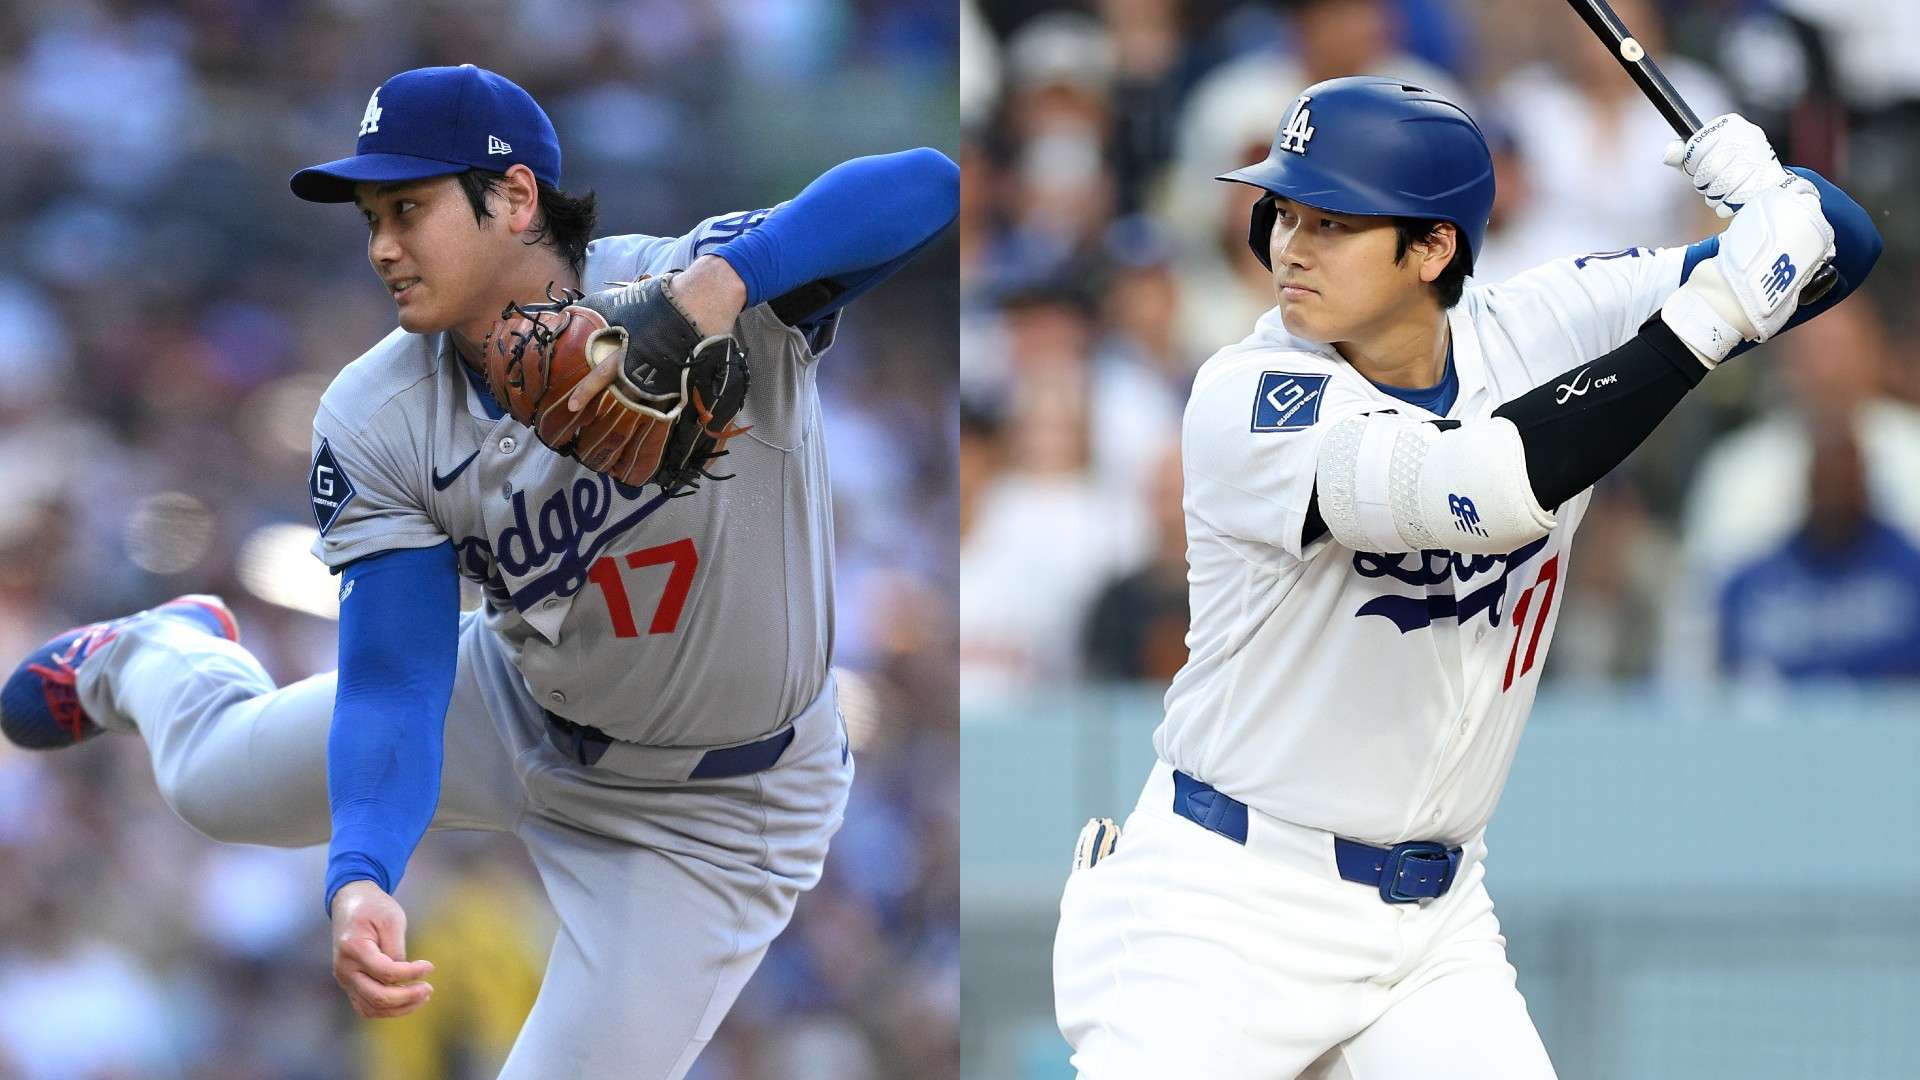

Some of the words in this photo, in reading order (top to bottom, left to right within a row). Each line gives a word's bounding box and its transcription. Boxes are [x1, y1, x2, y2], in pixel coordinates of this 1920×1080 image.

[358, 86, 383, 138] LA
[1280, 96, 1315, 155] LA
[1684, 142, 1696, 165] new
[1693, 117, 1729, 144] balance
[1266, 378, 1305, 412] G
[316, 464, 334, 497] G
[588, 537, 699, 638] 17
[1502, 550, 1560, 694] 17
